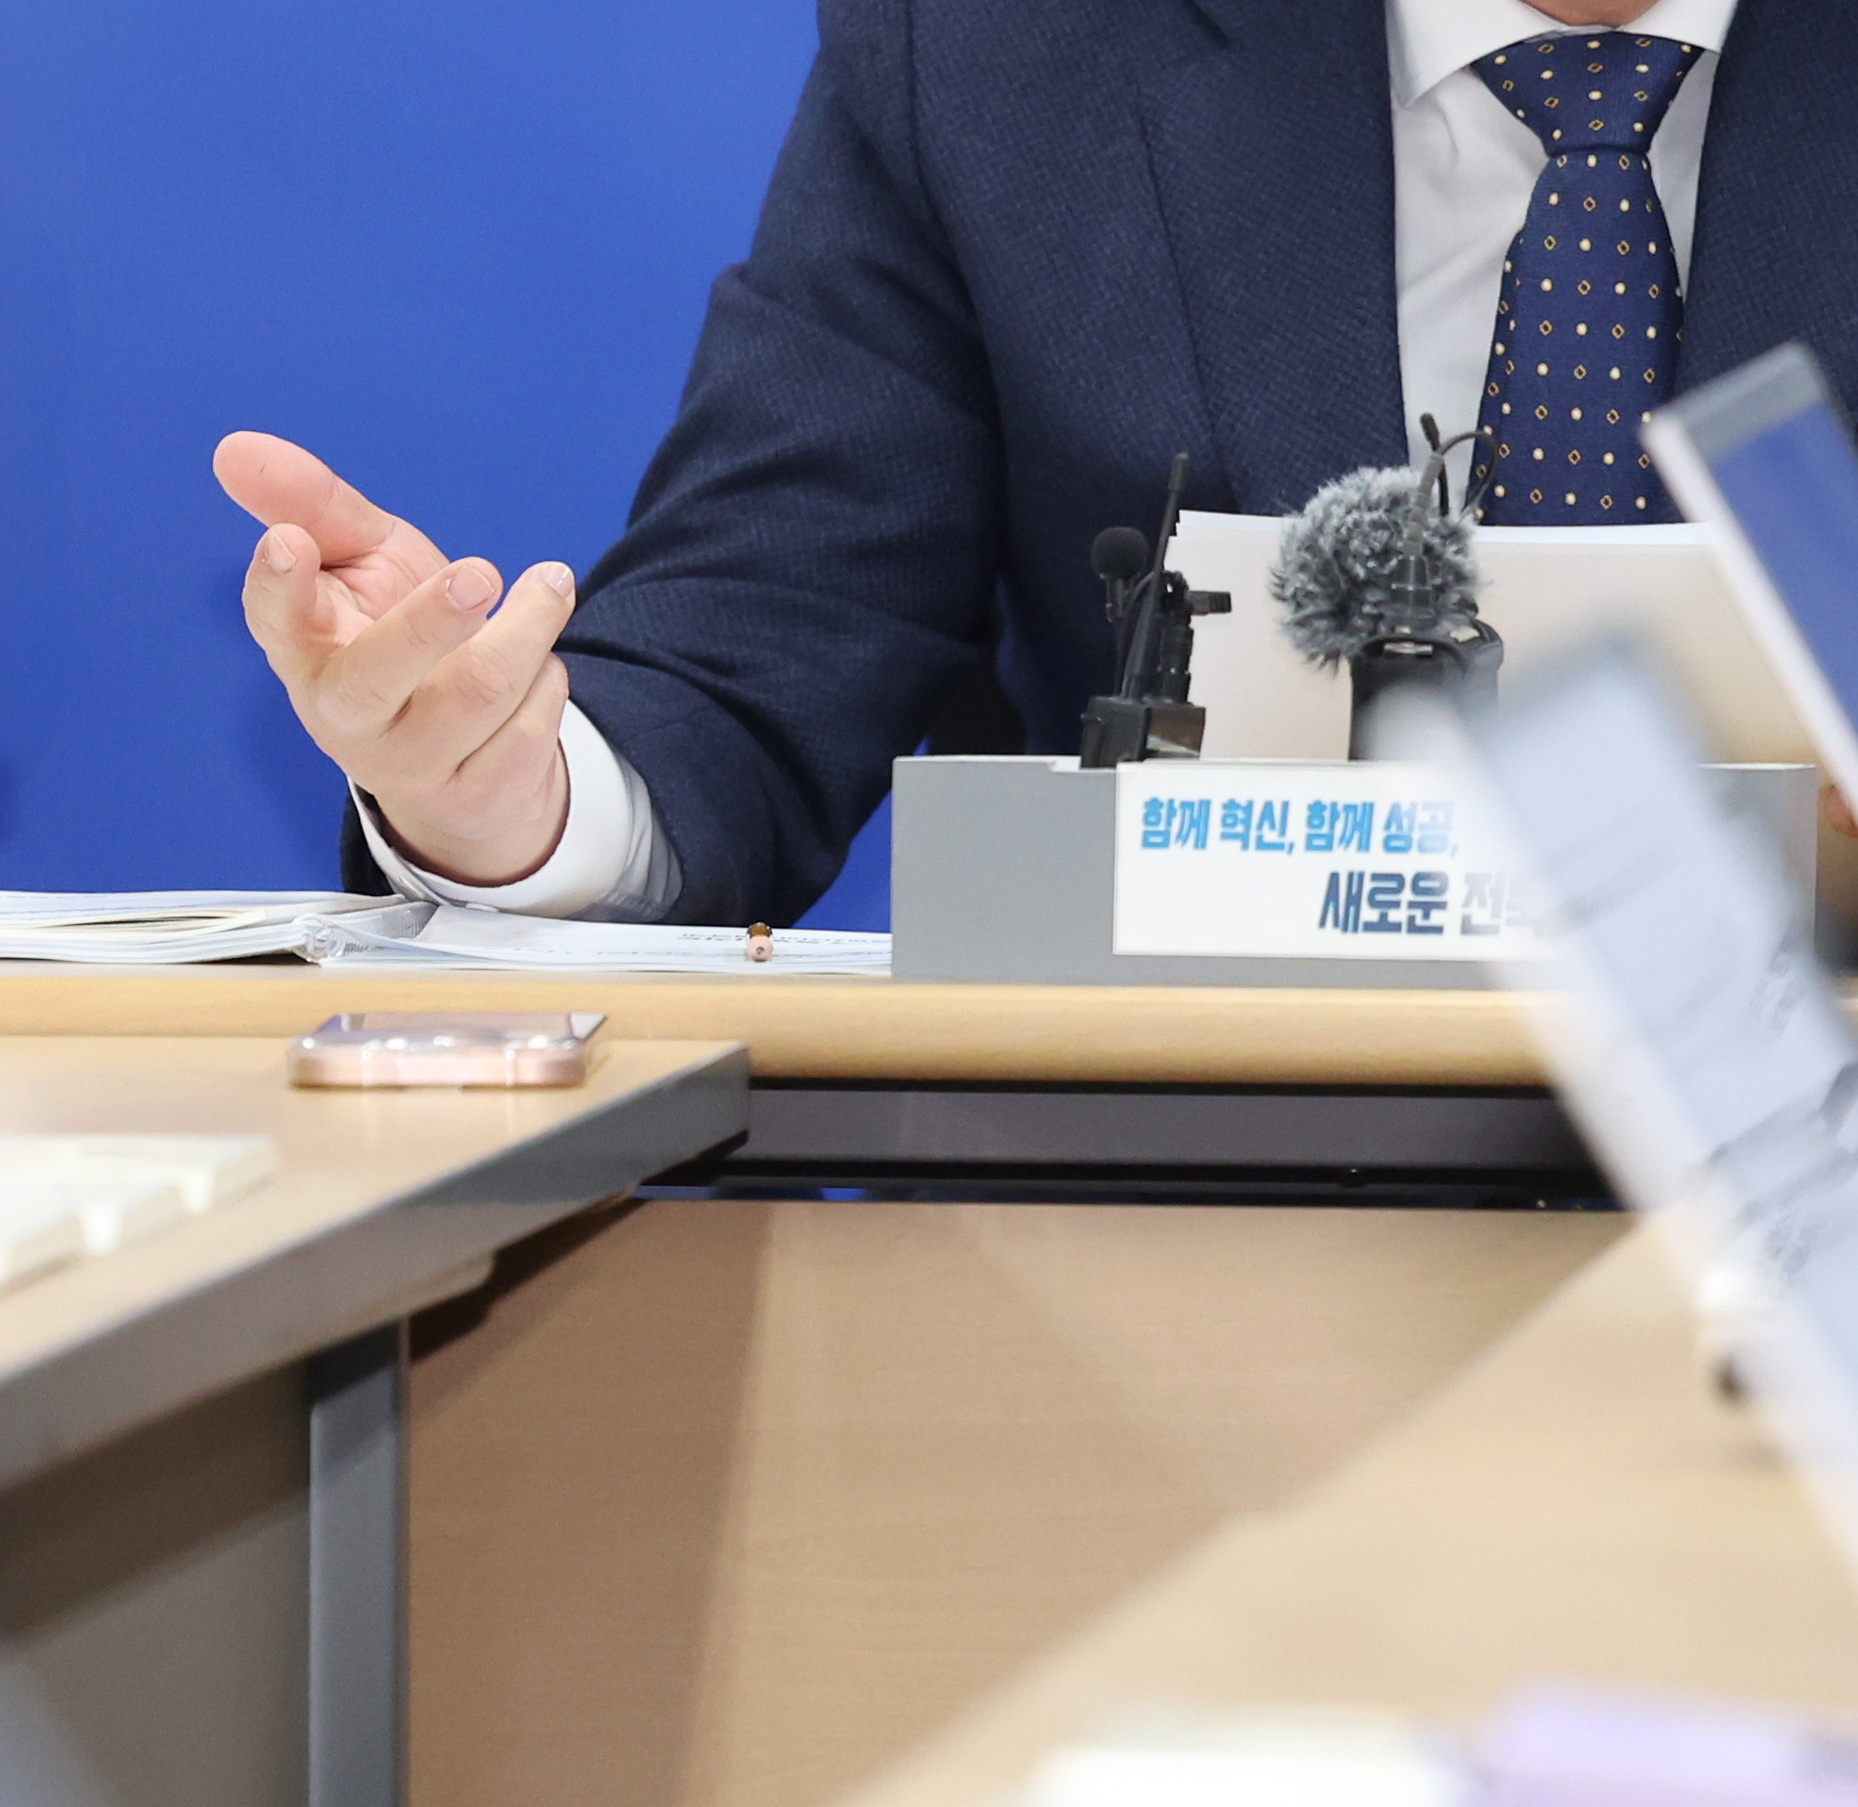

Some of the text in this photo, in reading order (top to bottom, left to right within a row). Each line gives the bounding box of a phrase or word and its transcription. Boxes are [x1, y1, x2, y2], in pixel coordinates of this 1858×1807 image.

[1140, 797, 1459, 857] 함께 혁신, 함께 성공,
[1317, 870, 1450, 935] 새로운
